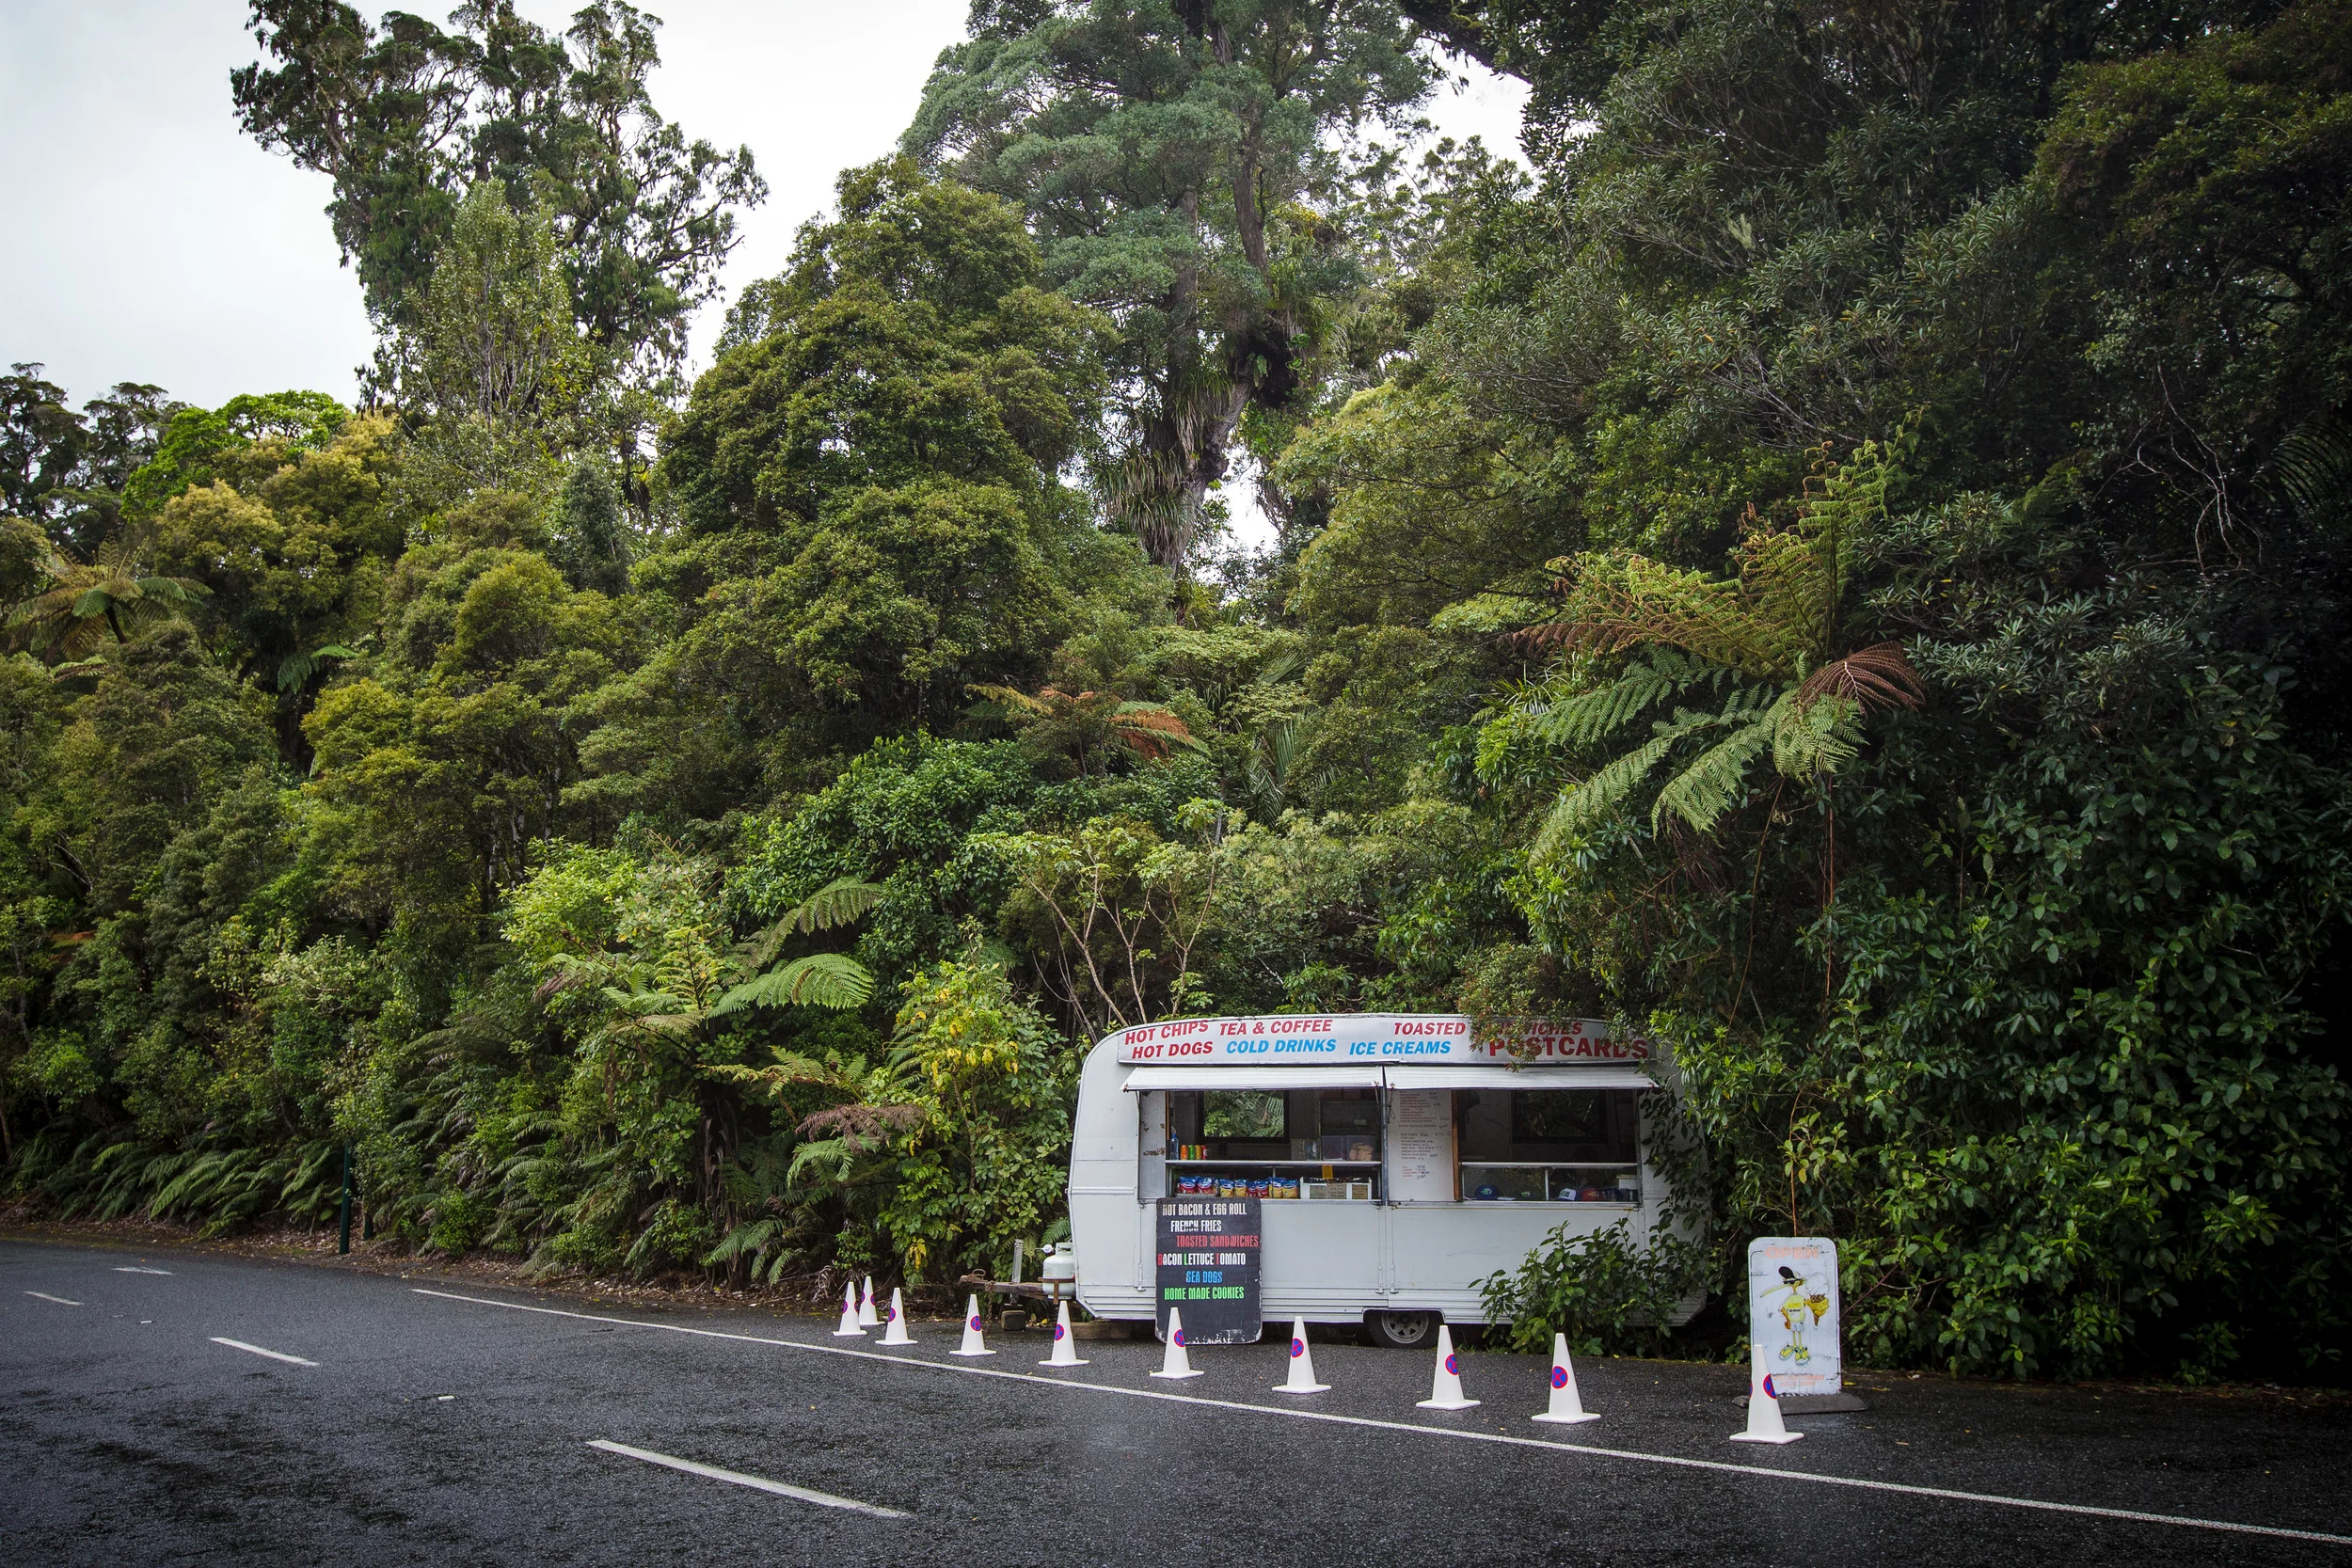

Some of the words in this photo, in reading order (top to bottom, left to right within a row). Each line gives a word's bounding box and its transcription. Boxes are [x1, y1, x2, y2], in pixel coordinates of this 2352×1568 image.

[1124, 1028, 1156, 1046] HOT
[1160, 1019, 1209, 1039] CHIPS
[1219, 1022, 1248, 1036] TEA
[1252, 1022, 1265, 1035] &
[1270, 1019, 1333, 1034] COFFEE
[1394, 1022, 1467, 1036] TOASTED
[1132, 1044, 1165, 1059] HOT
[1168, 1040, 1214, 1056] DOGS
[1226, 1039, 1270, 1054] COLD
[1274, 1038, 1337, 1053] DRINKS
[1349, 1041, 1377, 1055] ICE
[1381, 1040, 1452, 1054] CREAMS
[1162, 1204, 1177, 1216] HOT
[1178, 1203, 1203, 1216] BACON
[1204, 1203, 1211, 1215] &
[1213, 1203, 1228, 1215] EGG
[1229, 1203, 1248, 1215] ROLL
[1170, 1220, 1199, 1232] FRENCH
[1200, 1219, 1222, 1232] FRIES
[1176, 1235, 1208, 1247] TOASTED
[1210, 1235, 1259, 1247] SANDWICHES
[1157, 1253, 1183, 1266] BACON
[1184, 1253, 1215, 1266] LETTUCE
[1216, 1252, 1247, 1265] TOMATO
[1765, 1246, 1820, 1259] OPEN
[1185, 1271, 1200, 1283] SEA
[1202, 1271, 1223, 1283] DOGS
[1164, 1287, 1186, 1300] HOME
[1188, 1287, 1211, 1300] MADE
[1212, 1286, 1245, 1299] COOKIES
